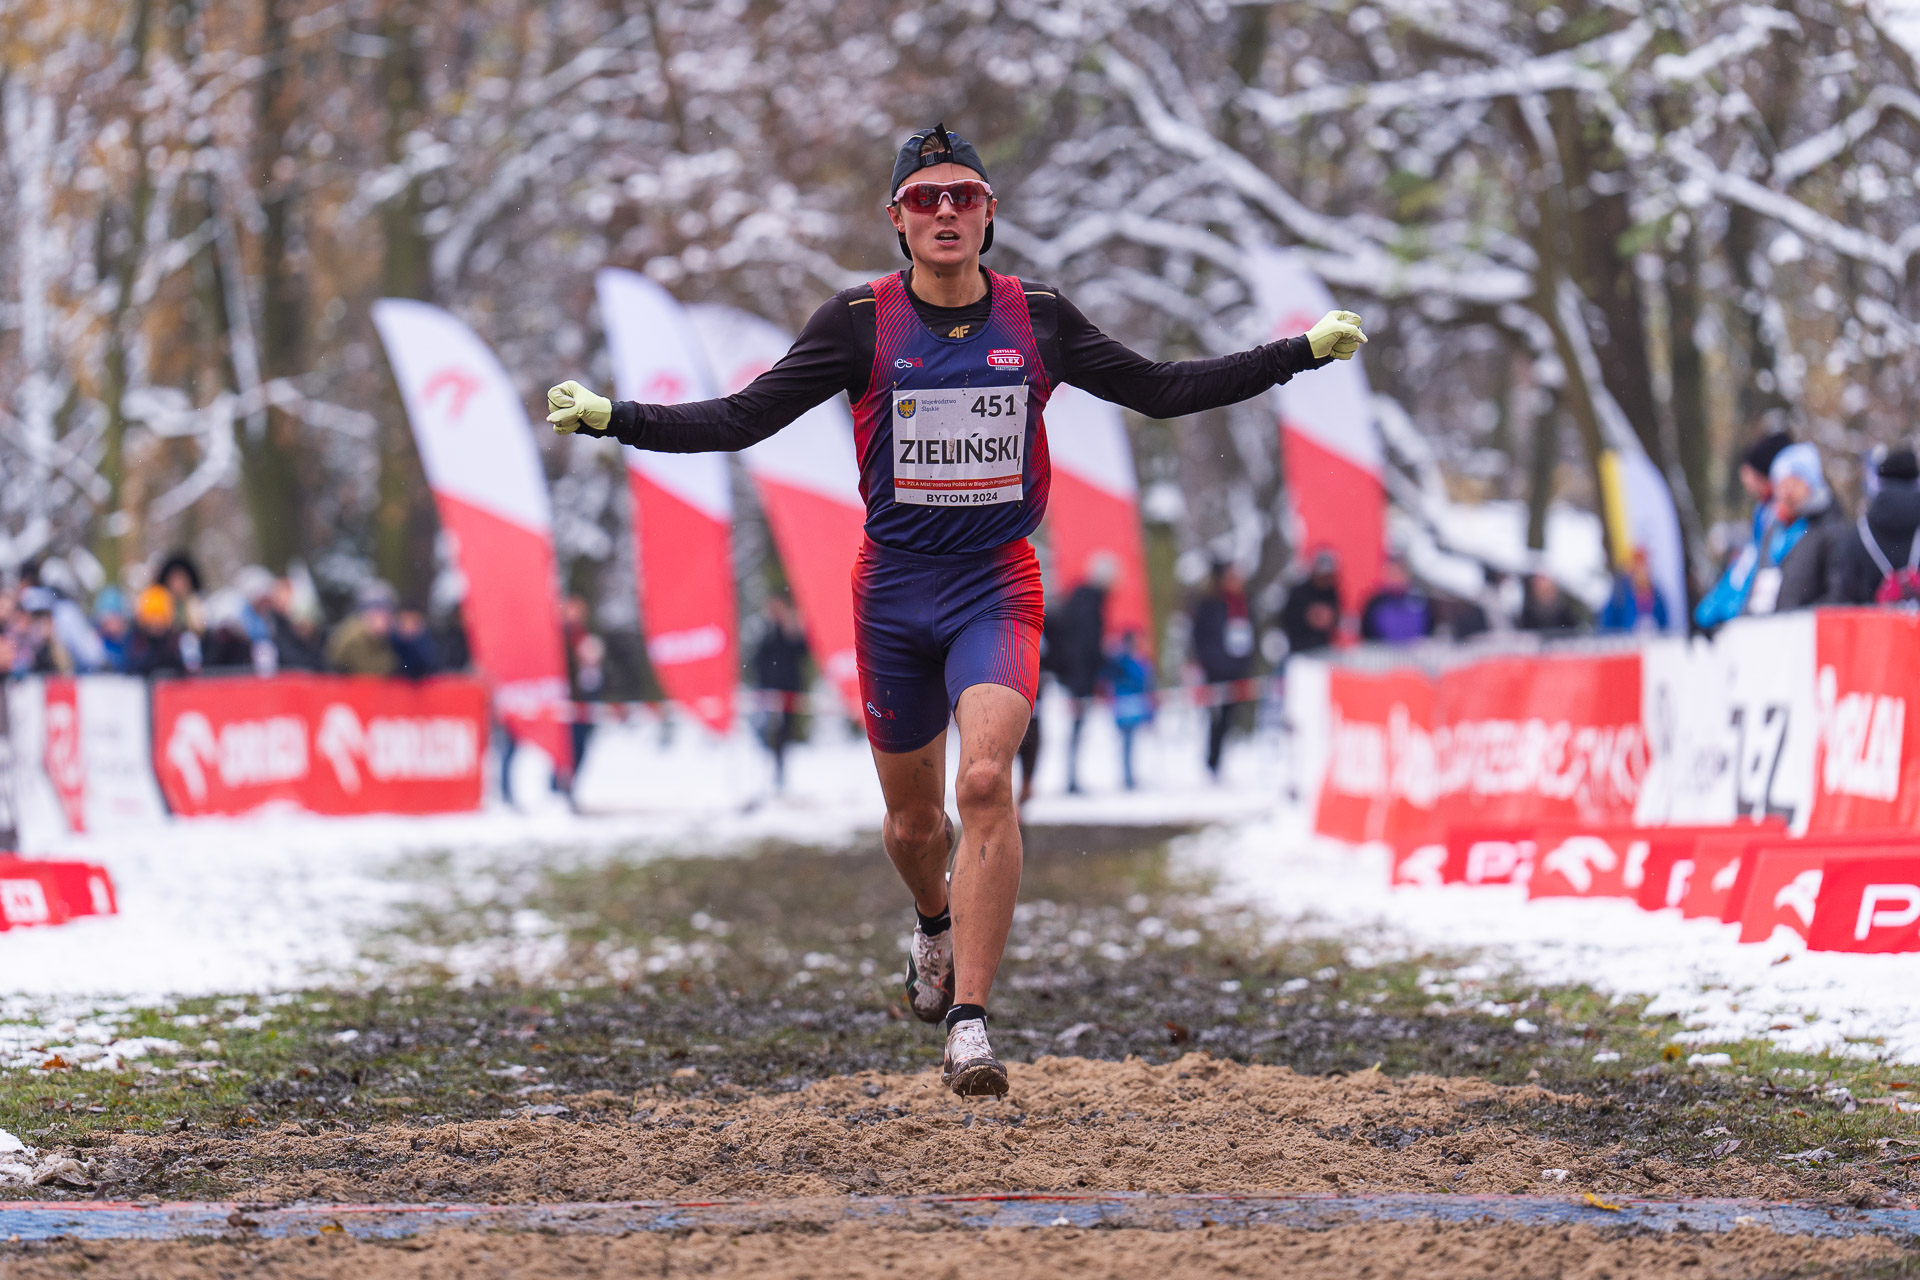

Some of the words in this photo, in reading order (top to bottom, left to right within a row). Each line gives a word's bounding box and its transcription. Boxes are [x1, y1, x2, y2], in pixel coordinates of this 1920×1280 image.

[949, 325, 970, 338] 4F
[991, 356, 1020, 365] TALEX
[921, 398, 957, 406] Województwo
[971, 394, 1016, 417] 451
[899, 433, 1019, 465] ZIELIŃSKI
[974, 479, 993, 487] Biegach
[926, 493, 970, 503] BYTOM
[972, 491, 998, 502] 2024
